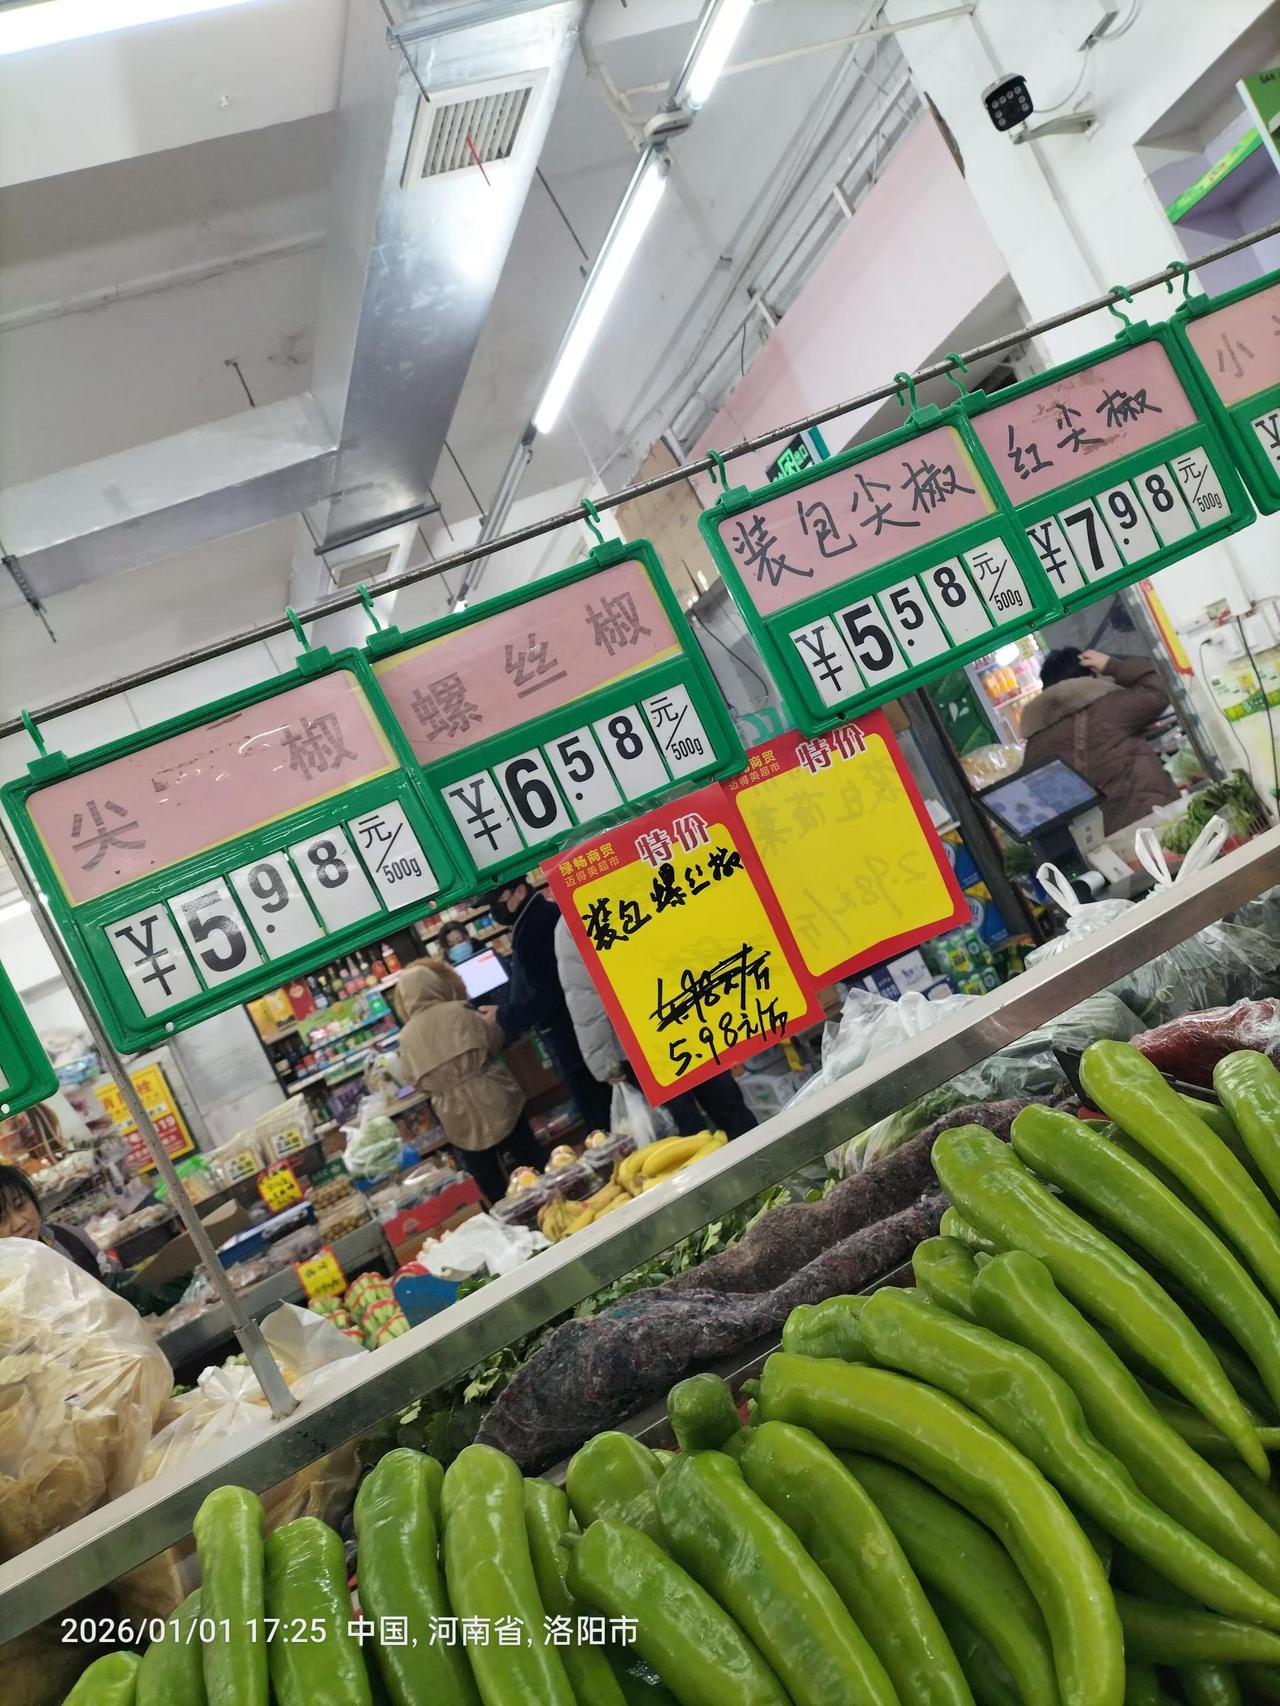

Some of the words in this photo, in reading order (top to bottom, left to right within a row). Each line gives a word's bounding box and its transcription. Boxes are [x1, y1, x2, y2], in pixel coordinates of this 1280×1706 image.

[1007, 386, 1163, 480] 红尖椒
[734, 457, 975, 587] 装包尖椒
[409, 591, 652, 742] 螺丝椒
[795, 723, 867, 776] 特价
[559, 842, 615, 877] 绿畅商贸
[634, 812, 712, 867] 特价
[564, 856, 620, 888] 迈得美超市
